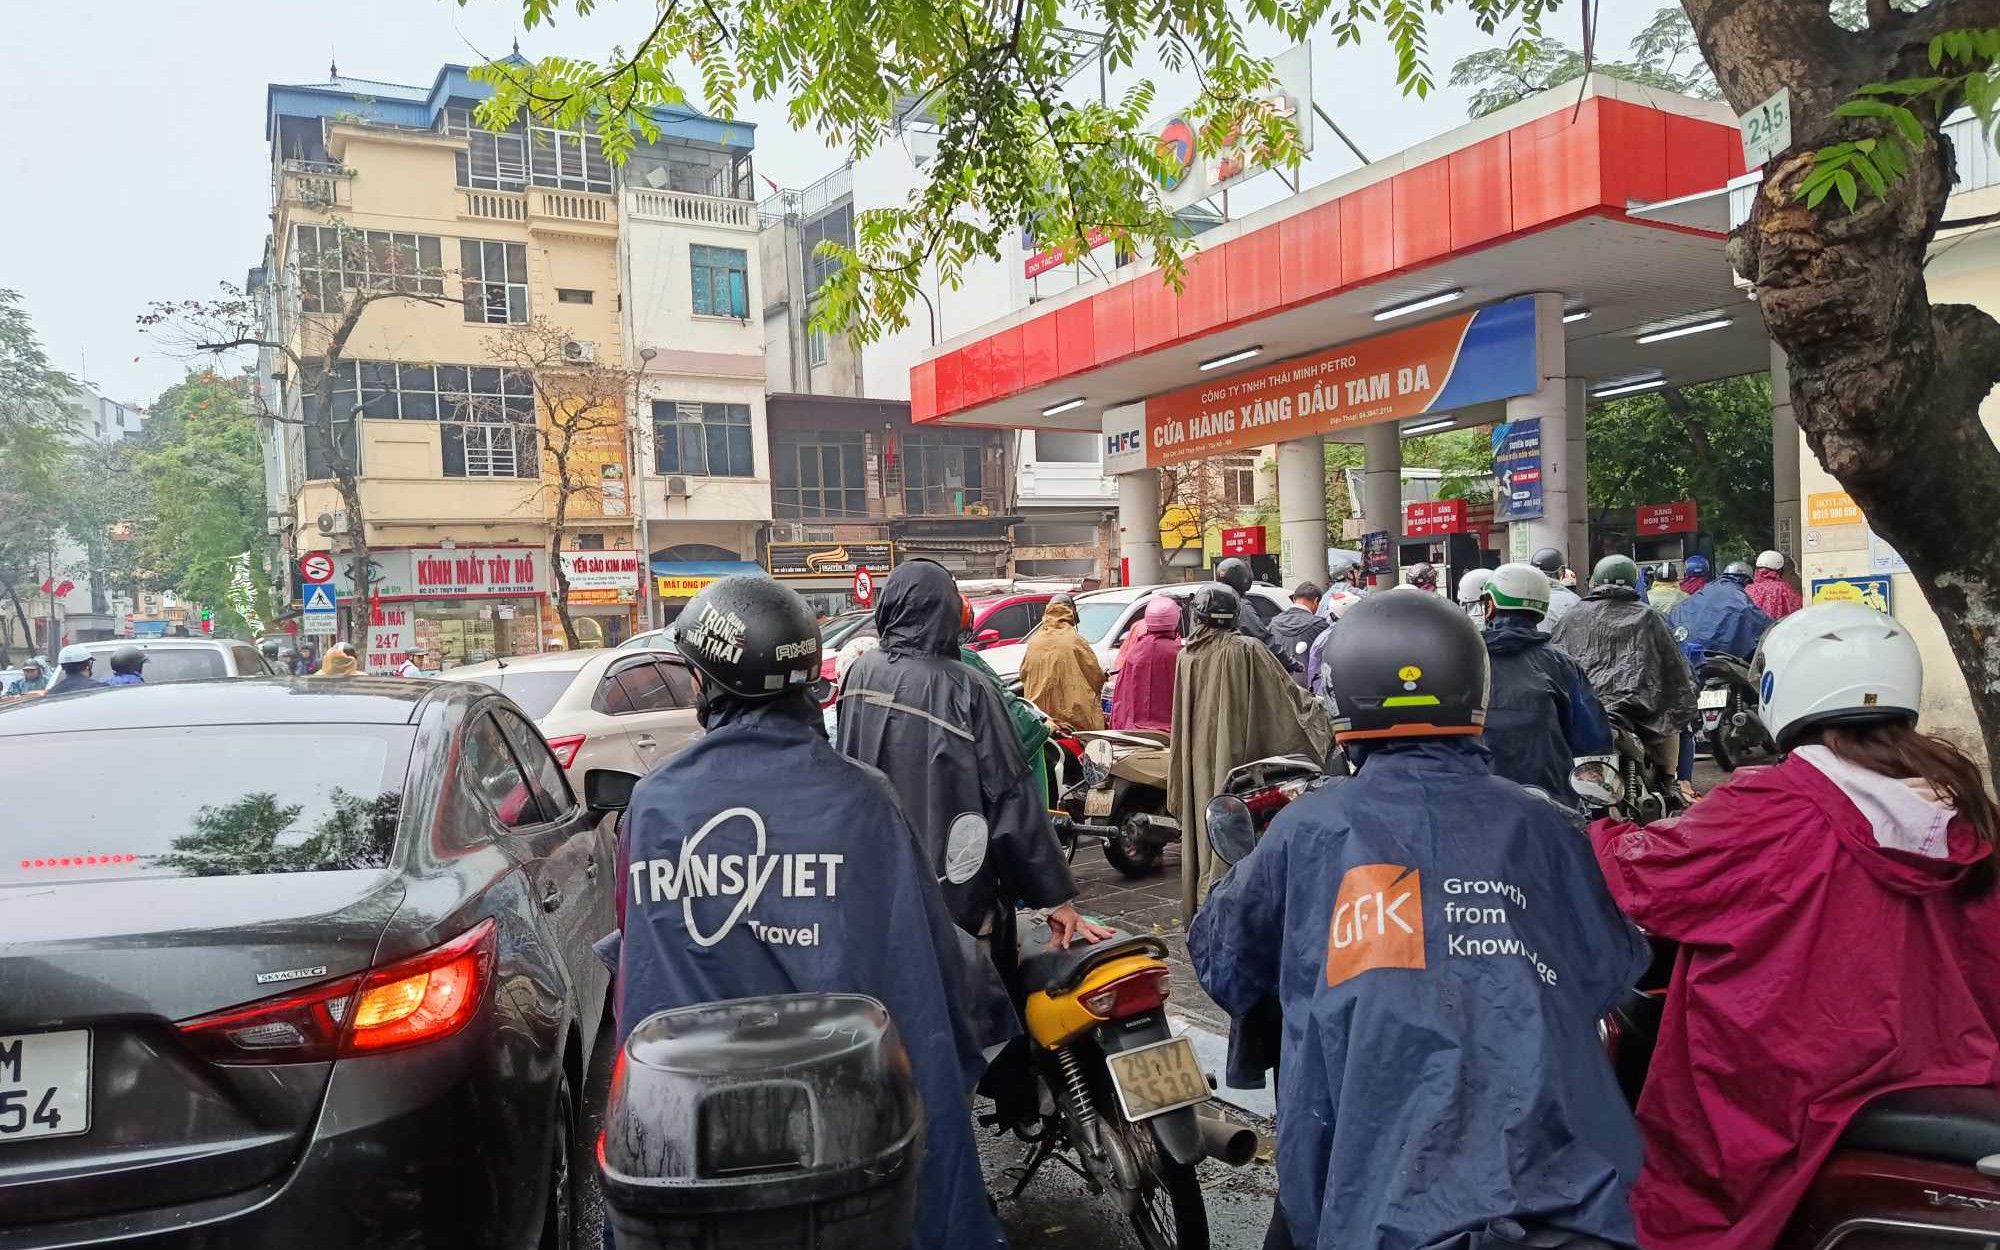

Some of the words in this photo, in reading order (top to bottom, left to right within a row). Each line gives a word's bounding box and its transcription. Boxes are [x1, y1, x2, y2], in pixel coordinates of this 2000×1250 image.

[1748, 101, 1783, 145] 245
[1201, 386, 1226, 404] CÔNG
[1242, 378, 1267, 395] TNHH
[1268, 371, 1291, 388] THÁI
[1293, 365, 1318, 381] MINH
[1320, 355, 1357, 374] PETRO
[1153, 417, 1185, 448] CỬA
[1188, 409, 1235, 440] HÀNG
[1240, 396, 1292, 430] XĂNG
[1298, 379, 1339, 417] DẦU
[1345, 372, 1391, 406] TAM
[1396, 364, 1431, 396] ĐA
[1107, 429, 1140, 454] HFC
[417, 554, 452, 585] KÍNH
[455, 549, 485, 585] MẮT
[487, 554, 511, 584] TÂY
[514, 550, 534, 583] HỒ
[572, 557, 588, 573] YẾN
[589, 556, 604, 573] SÀO
[605, 559, 620, 572] KIM
[620, 558, 636, 572] ANH
[682, 580, 698, 589] ONG
[375, 633, 400, 649] 247
[629, 840, 844, 910] TRANSVIET
[1443, 878, 1527, 910] Growth
[1444, 902, 1506, 924] from
[748, 920, 819, 946] Travel
